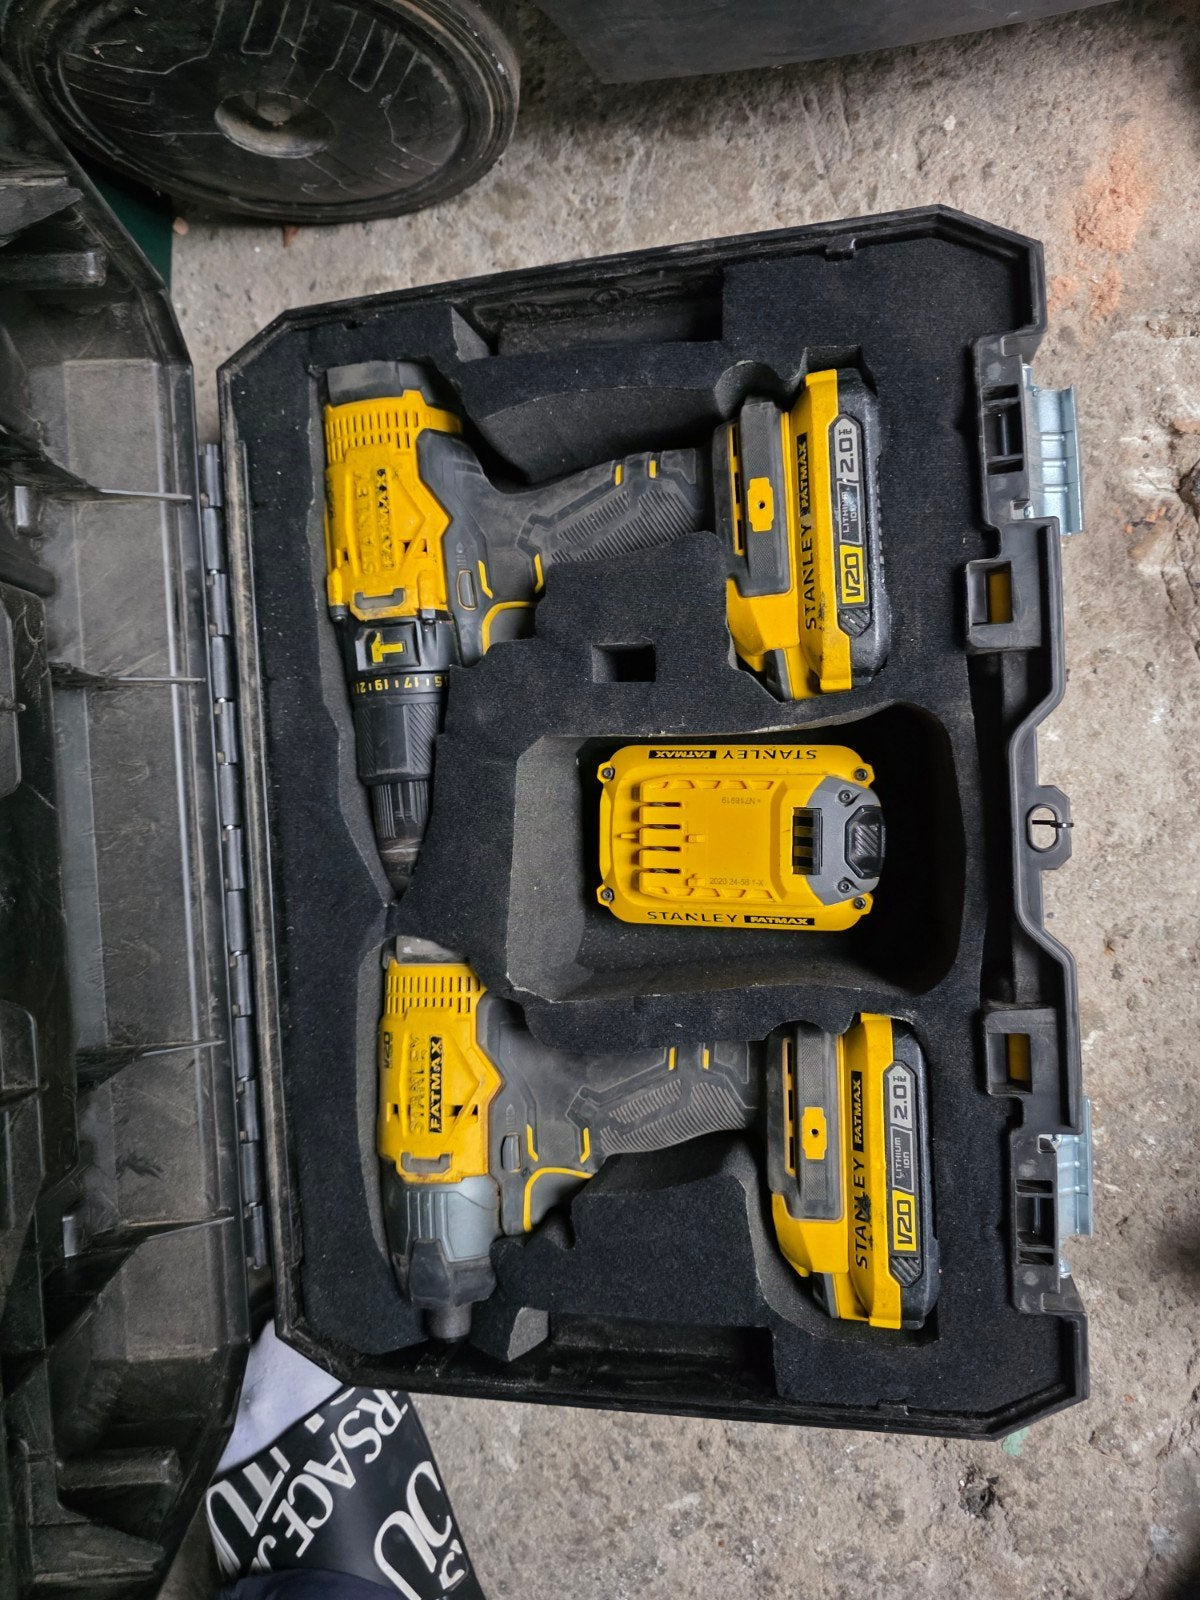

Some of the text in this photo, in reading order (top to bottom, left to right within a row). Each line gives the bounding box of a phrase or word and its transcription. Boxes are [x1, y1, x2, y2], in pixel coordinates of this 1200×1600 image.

[838, 437, 855, 474] 2.0
[798, 439, 817, 630] STANLEY FATMAX
[844, 552, 861, 598] V20
[374, 678, 390, 691] 19
[403, 676, 420, 689] 17
[654, 749, 817, 760] STANLEY FATMAX
[647, 911, 809, 925] STANLEY FATMAX
[430, 1037, 442, 1129] FATMAX
[893, 1084, 908, 1120] 2.0
[852, 1079, 868, 1269] STANLEY FATMAX
[895, 1136, 903, 1179] LITHIUM
[897, 1200, 912, 1245] V20
